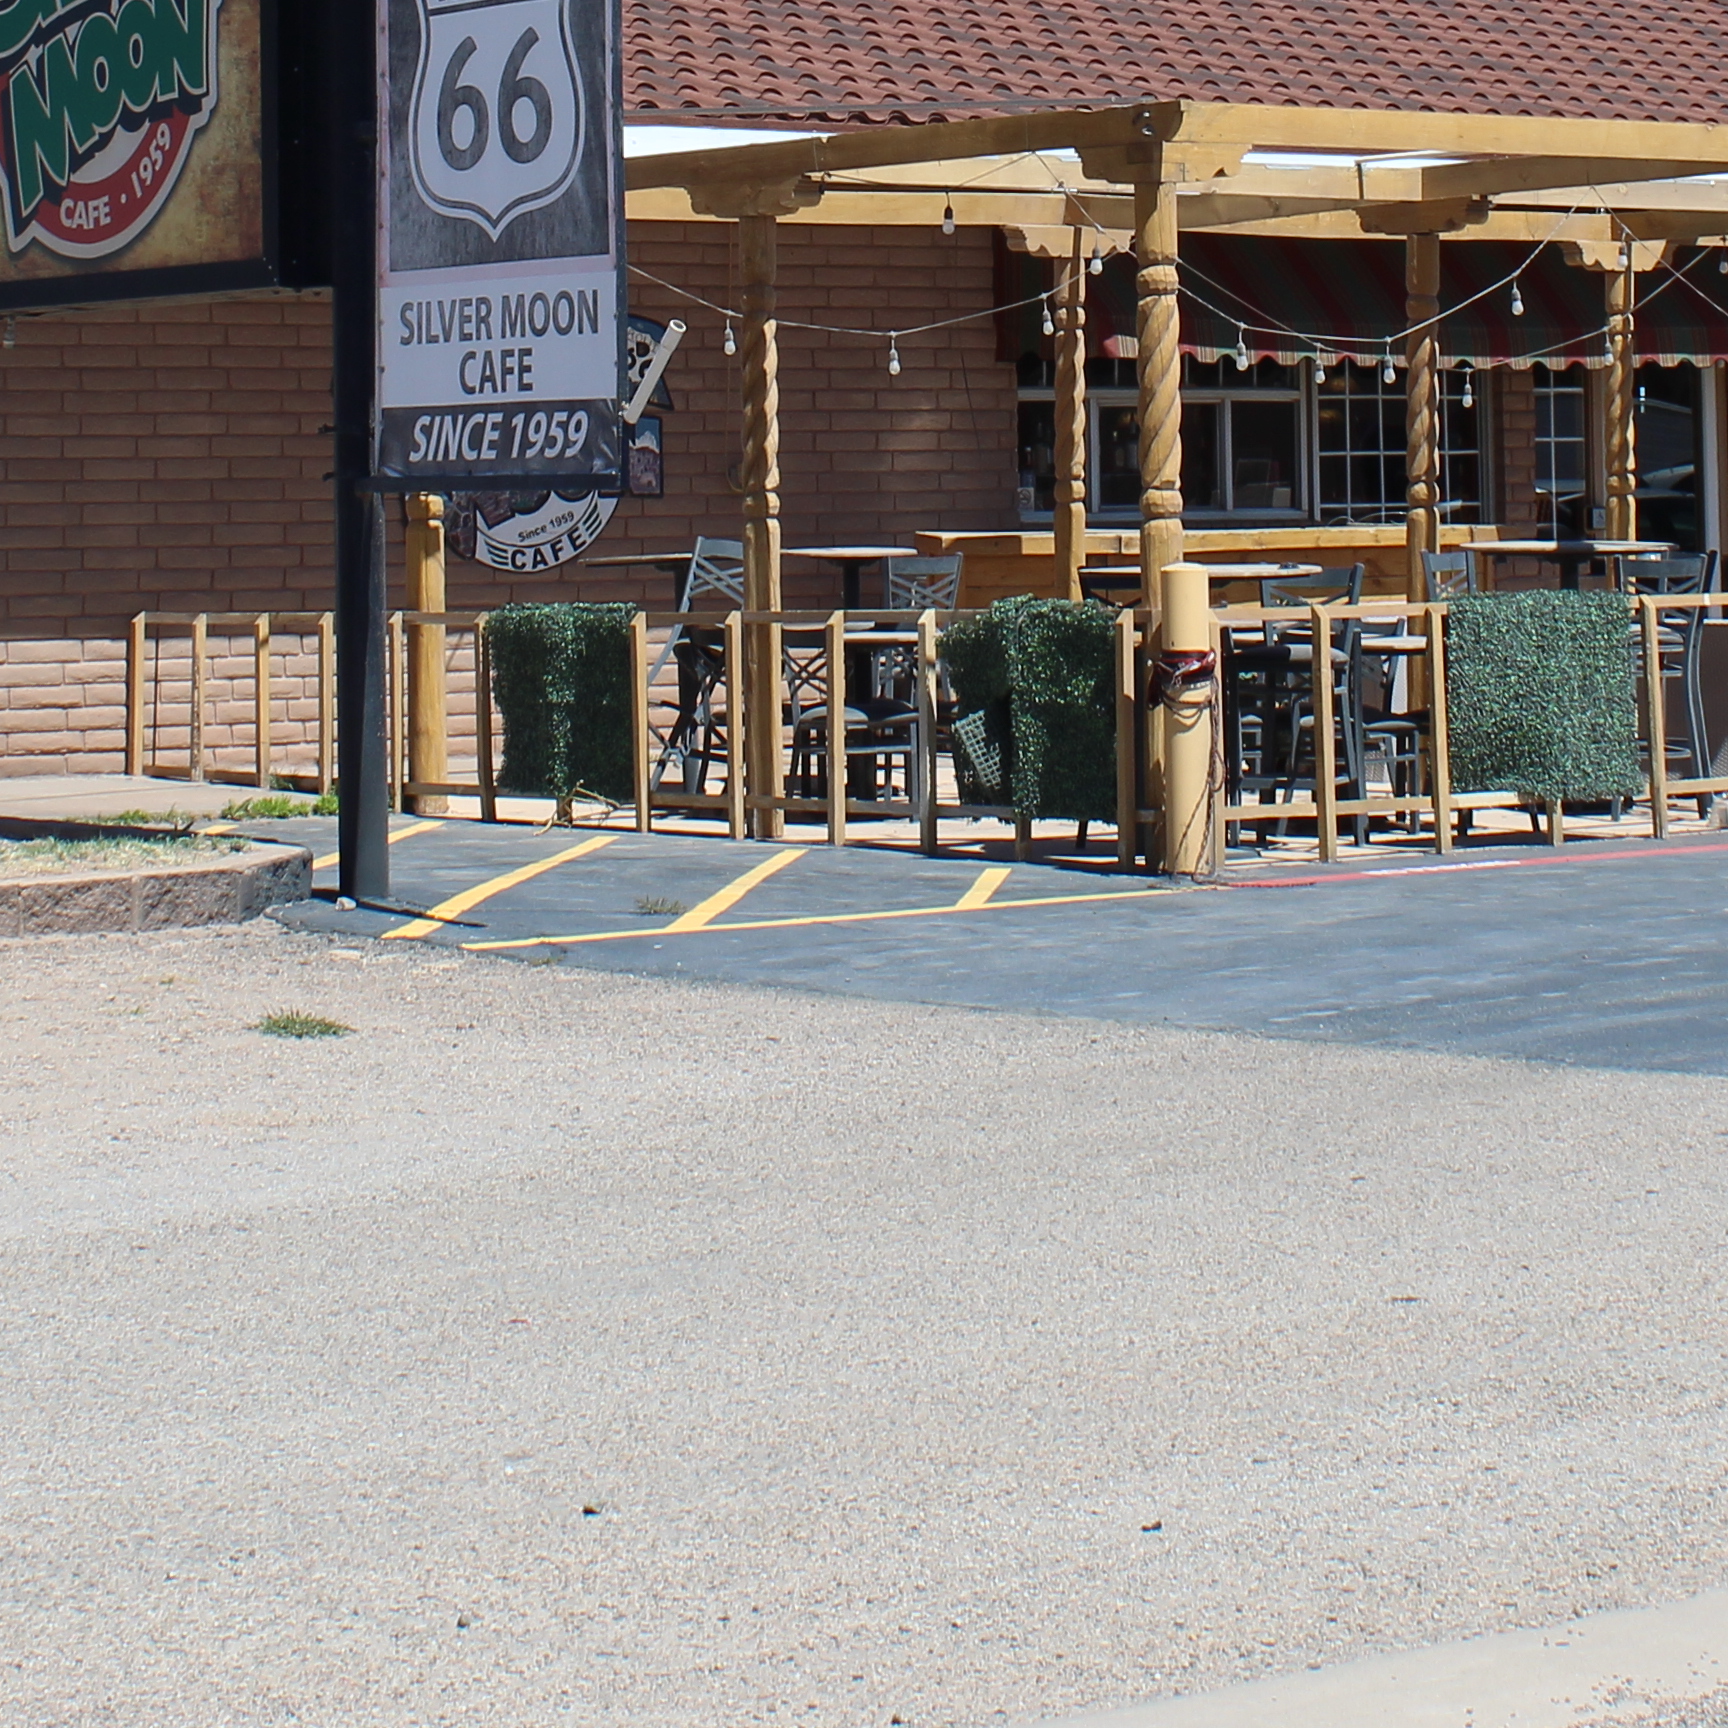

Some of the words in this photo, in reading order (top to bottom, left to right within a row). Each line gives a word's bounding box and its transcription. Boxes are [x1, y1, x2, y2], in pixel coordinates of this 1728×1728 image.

[436, 26, 554, 171] 66
[60, 195, 111, 229] CAFE
[131, 123, 171, 198] 1959
[399, 295, 492, 346] SILVER
[501, 289, 599, 340] MOON
[458, 347, 534, 395] CAFE
[409, 412, 505, 463] SINCE
[510, 409, 589, 459] 1959
[510, 526, 587, 570] CAFE
[517, 524, 548, 542] Since
[549, 511, 576, 529] 1959
